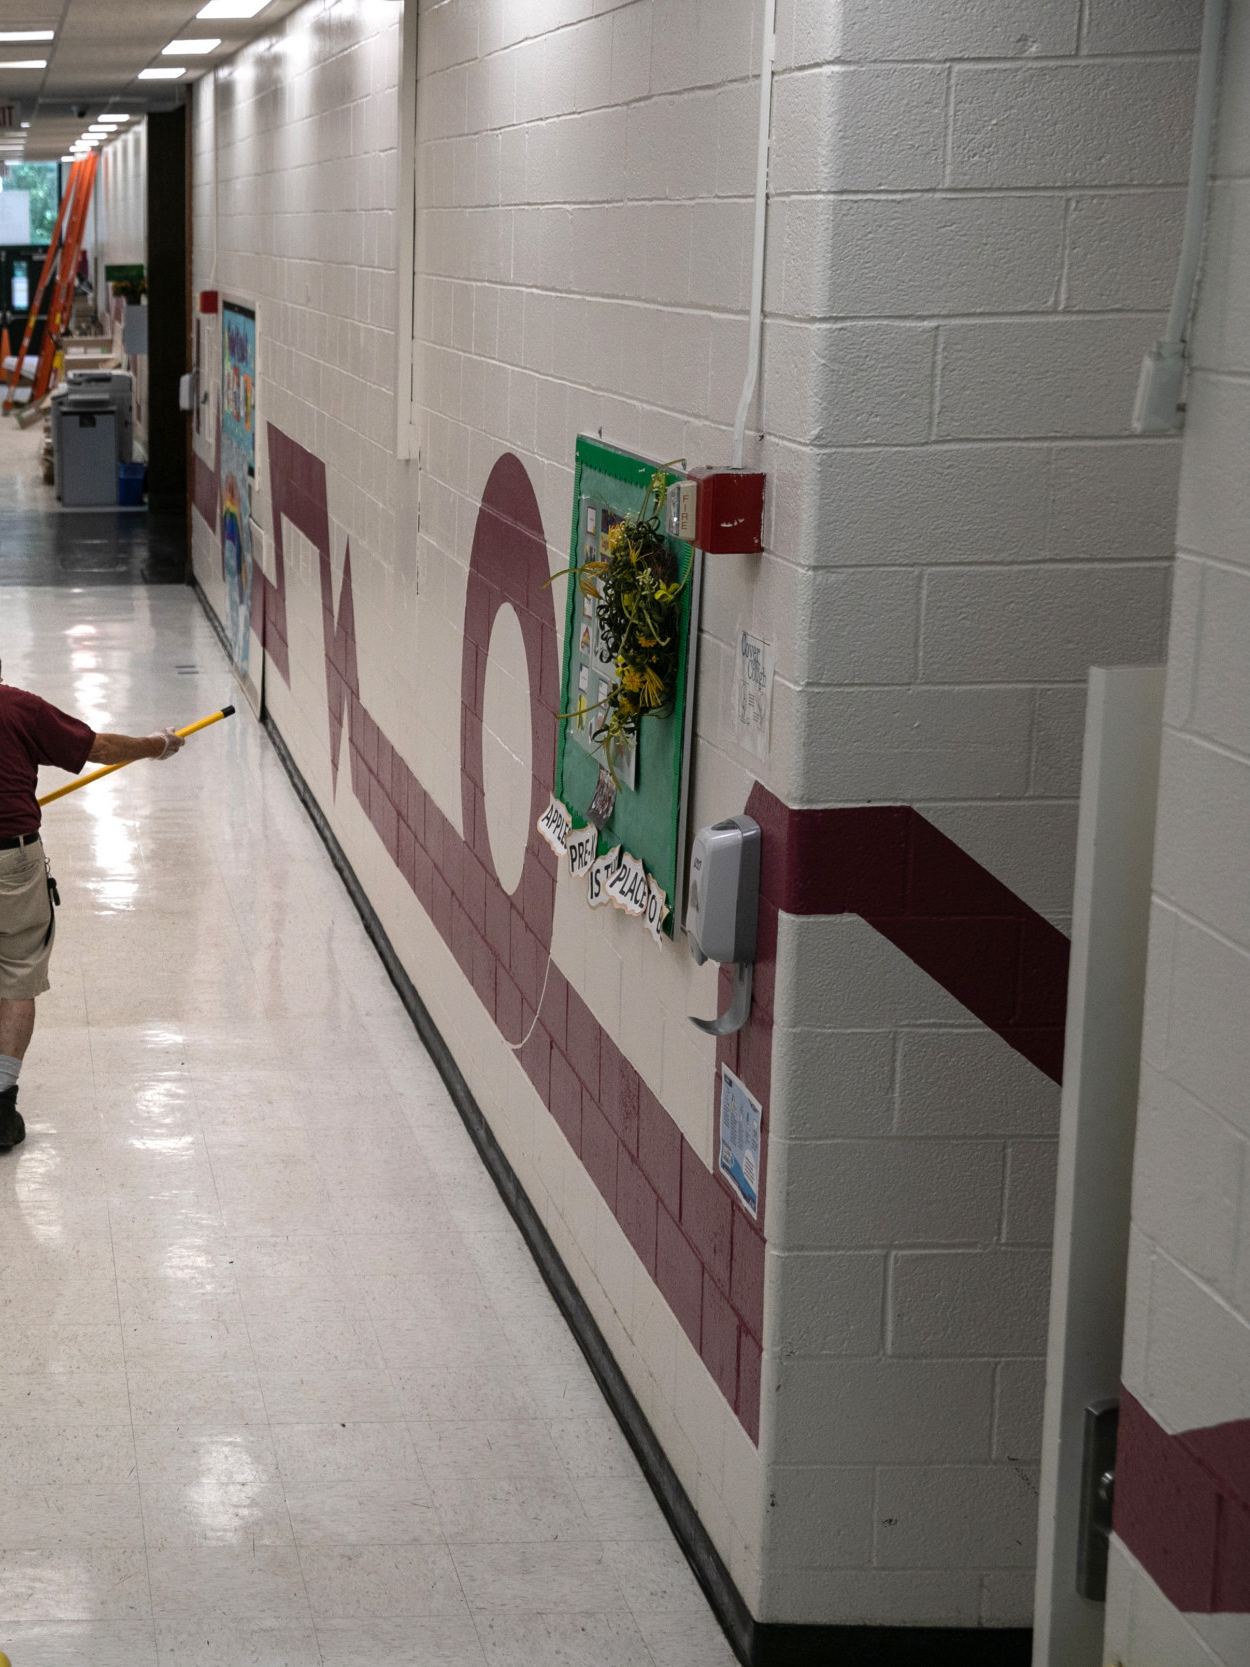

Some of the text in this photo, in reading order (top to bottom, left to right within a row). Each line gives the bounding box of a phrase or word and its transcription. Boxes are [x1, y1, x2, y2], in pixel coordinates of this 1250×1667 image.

[681, 494, 690, 531] FIRE
[742, 632, 761, 661] Cover
[569, 832, 597, 873] PRE-K
[590, 868, 601, 901] IS
[608, 863, 649, 910] PLACE
